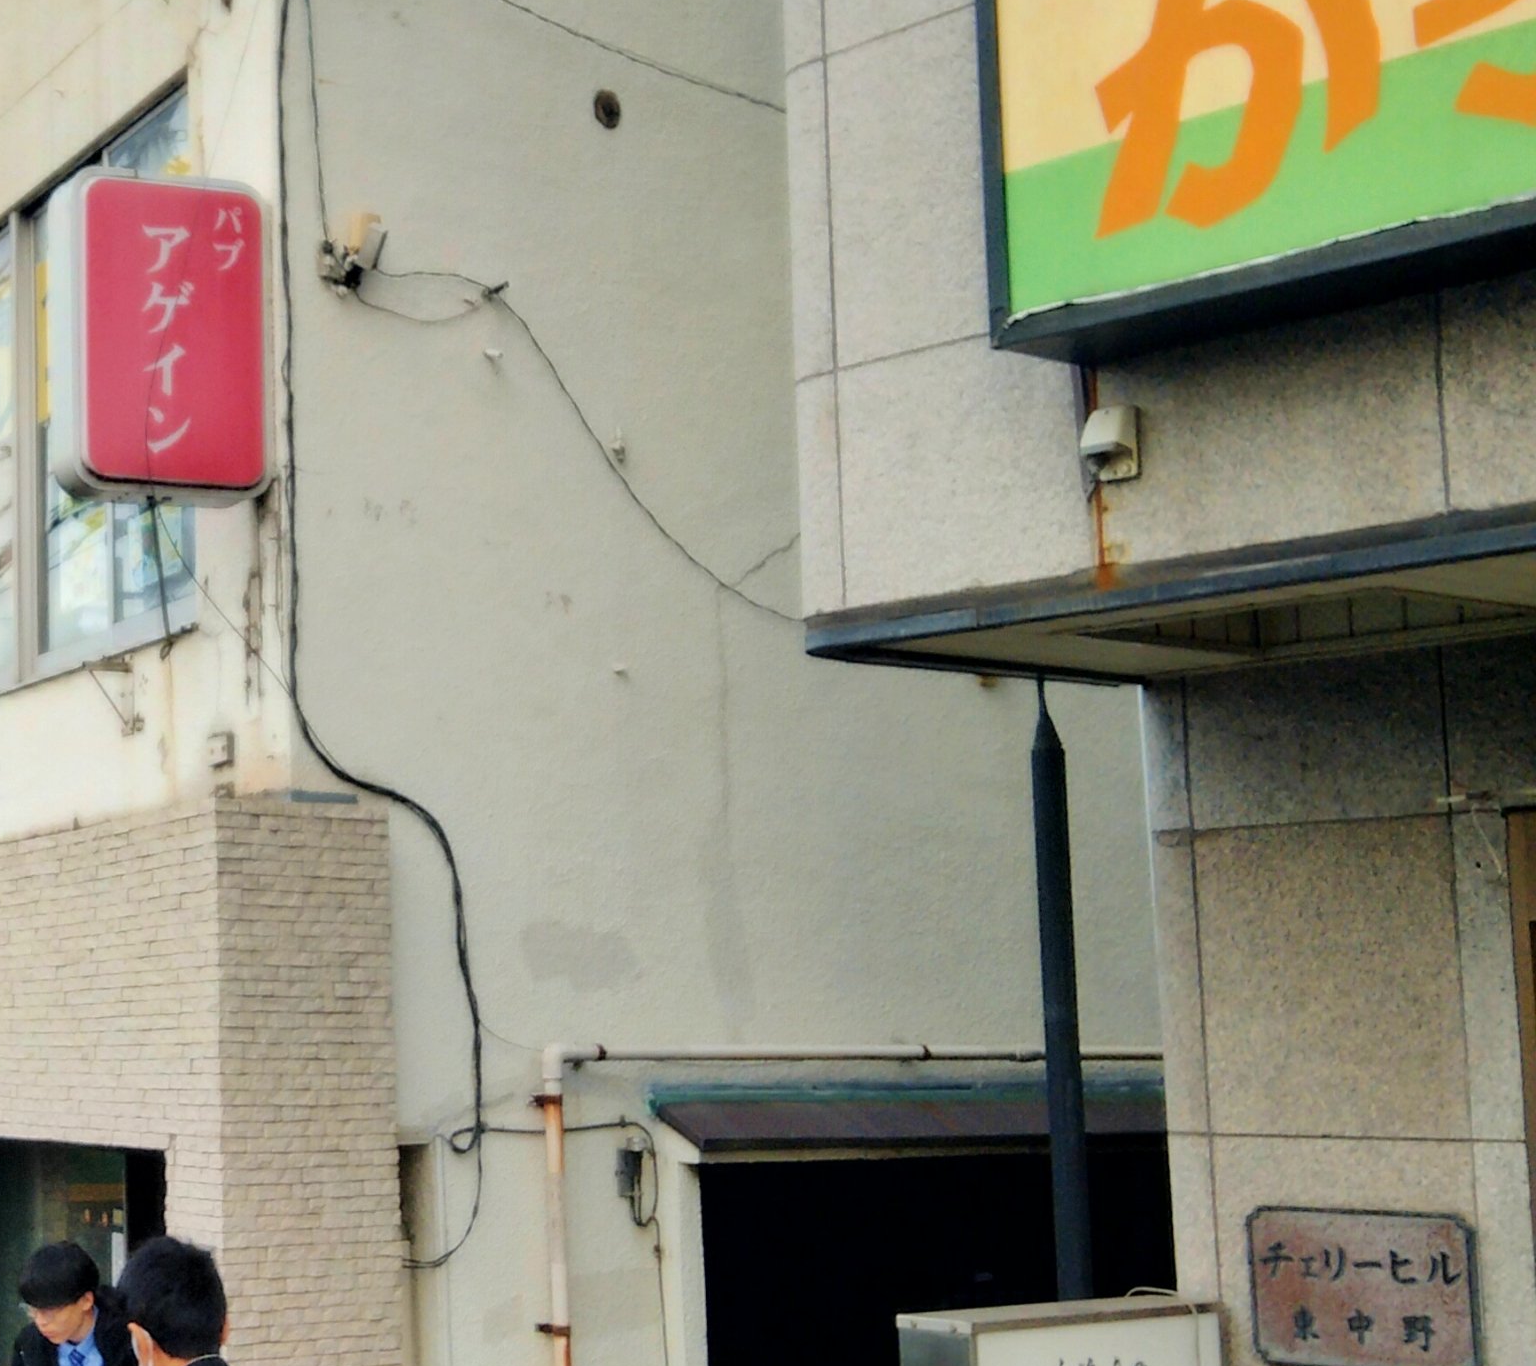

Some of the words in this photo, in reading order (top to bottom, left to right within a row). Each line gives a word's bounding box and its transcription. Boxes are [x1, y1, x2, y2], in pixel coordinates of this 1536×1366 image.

[212, 206, 246, 273] パブ
[141, 223, 195, 455] アゲイン
[1258, 1240, 1464, 1289] チェリーヒル
[1291, 1312, 1437, 1354] 東中野
